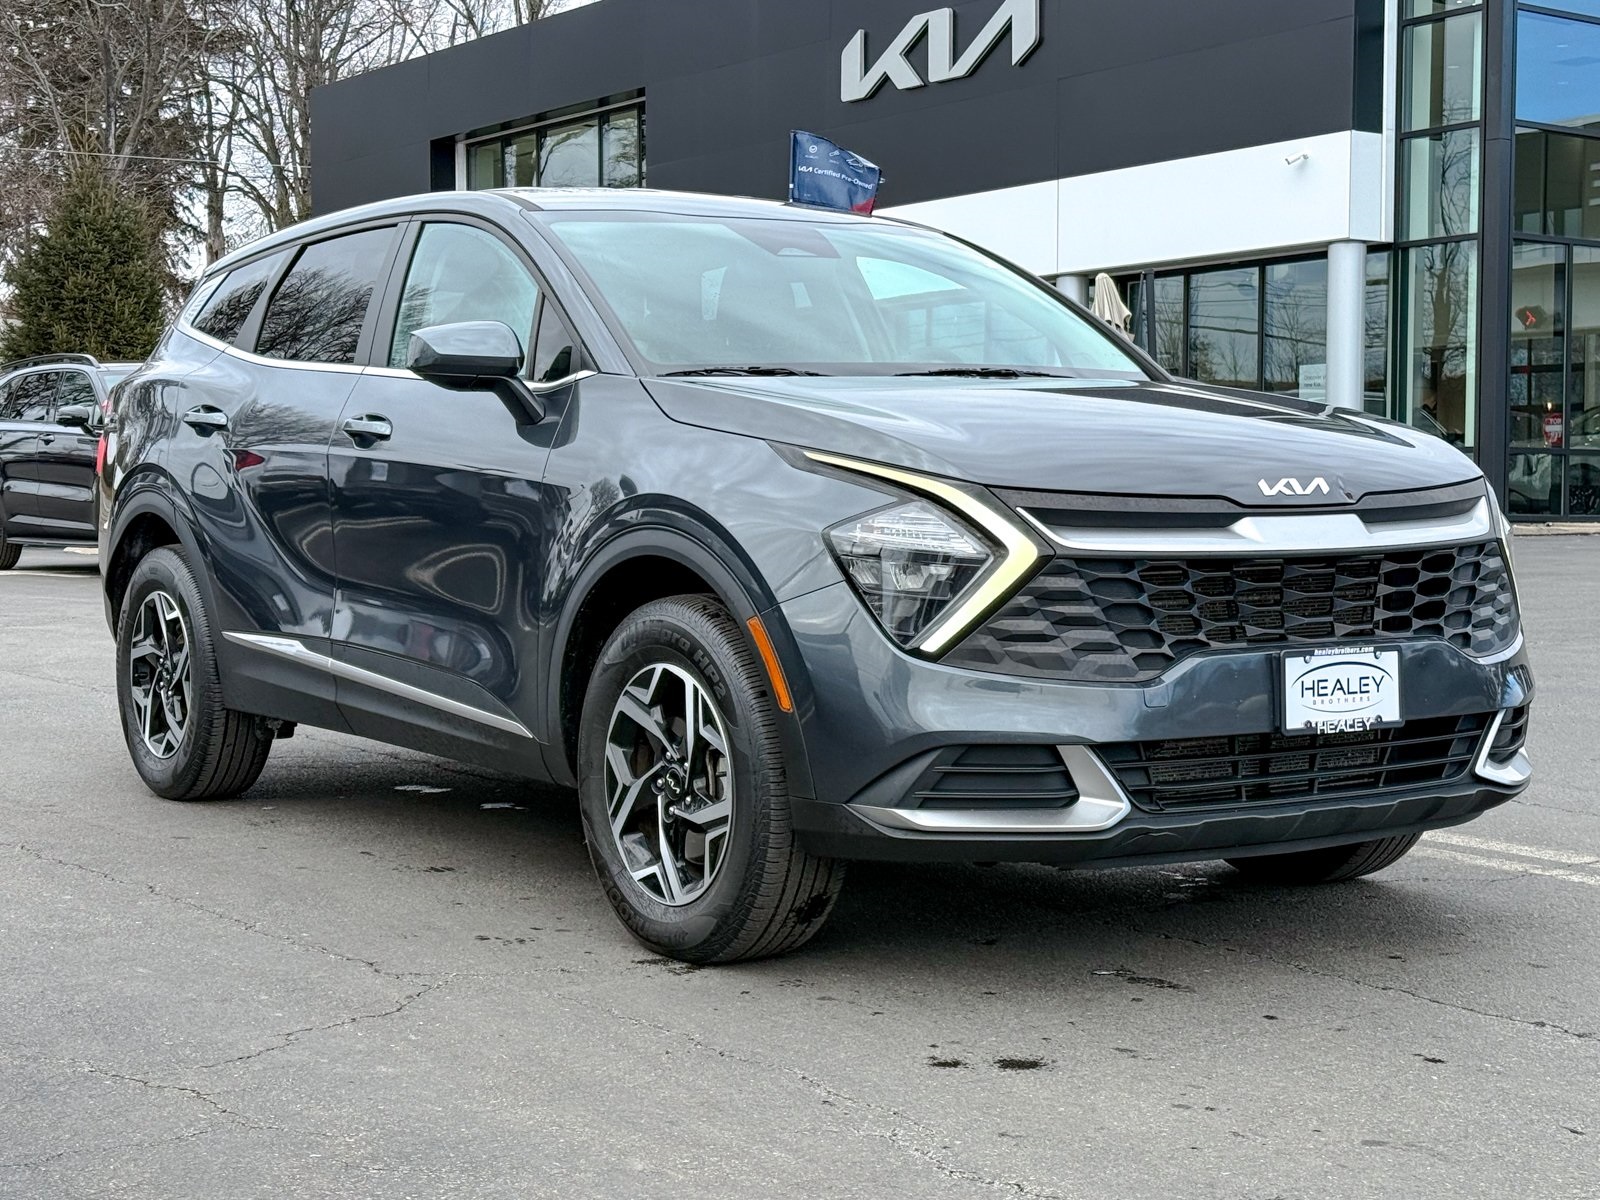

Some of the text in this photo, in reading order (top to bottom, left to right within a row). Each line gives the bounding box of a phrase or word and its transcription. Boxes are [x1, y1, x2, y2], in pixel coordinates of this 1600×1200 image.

[841, 0, 1039, 102] KIA
[814, 167, 841, 178] Certified
[1257, 477, 1330, 496] KIA
[1314, 646, 1375, 656] healeybrothers.com
[1301, 675, 1385, 698] HEALEY
[1313, 696, 1370, 705] BROTHERS
[1316, 717, 1372, 735] HEALEY
